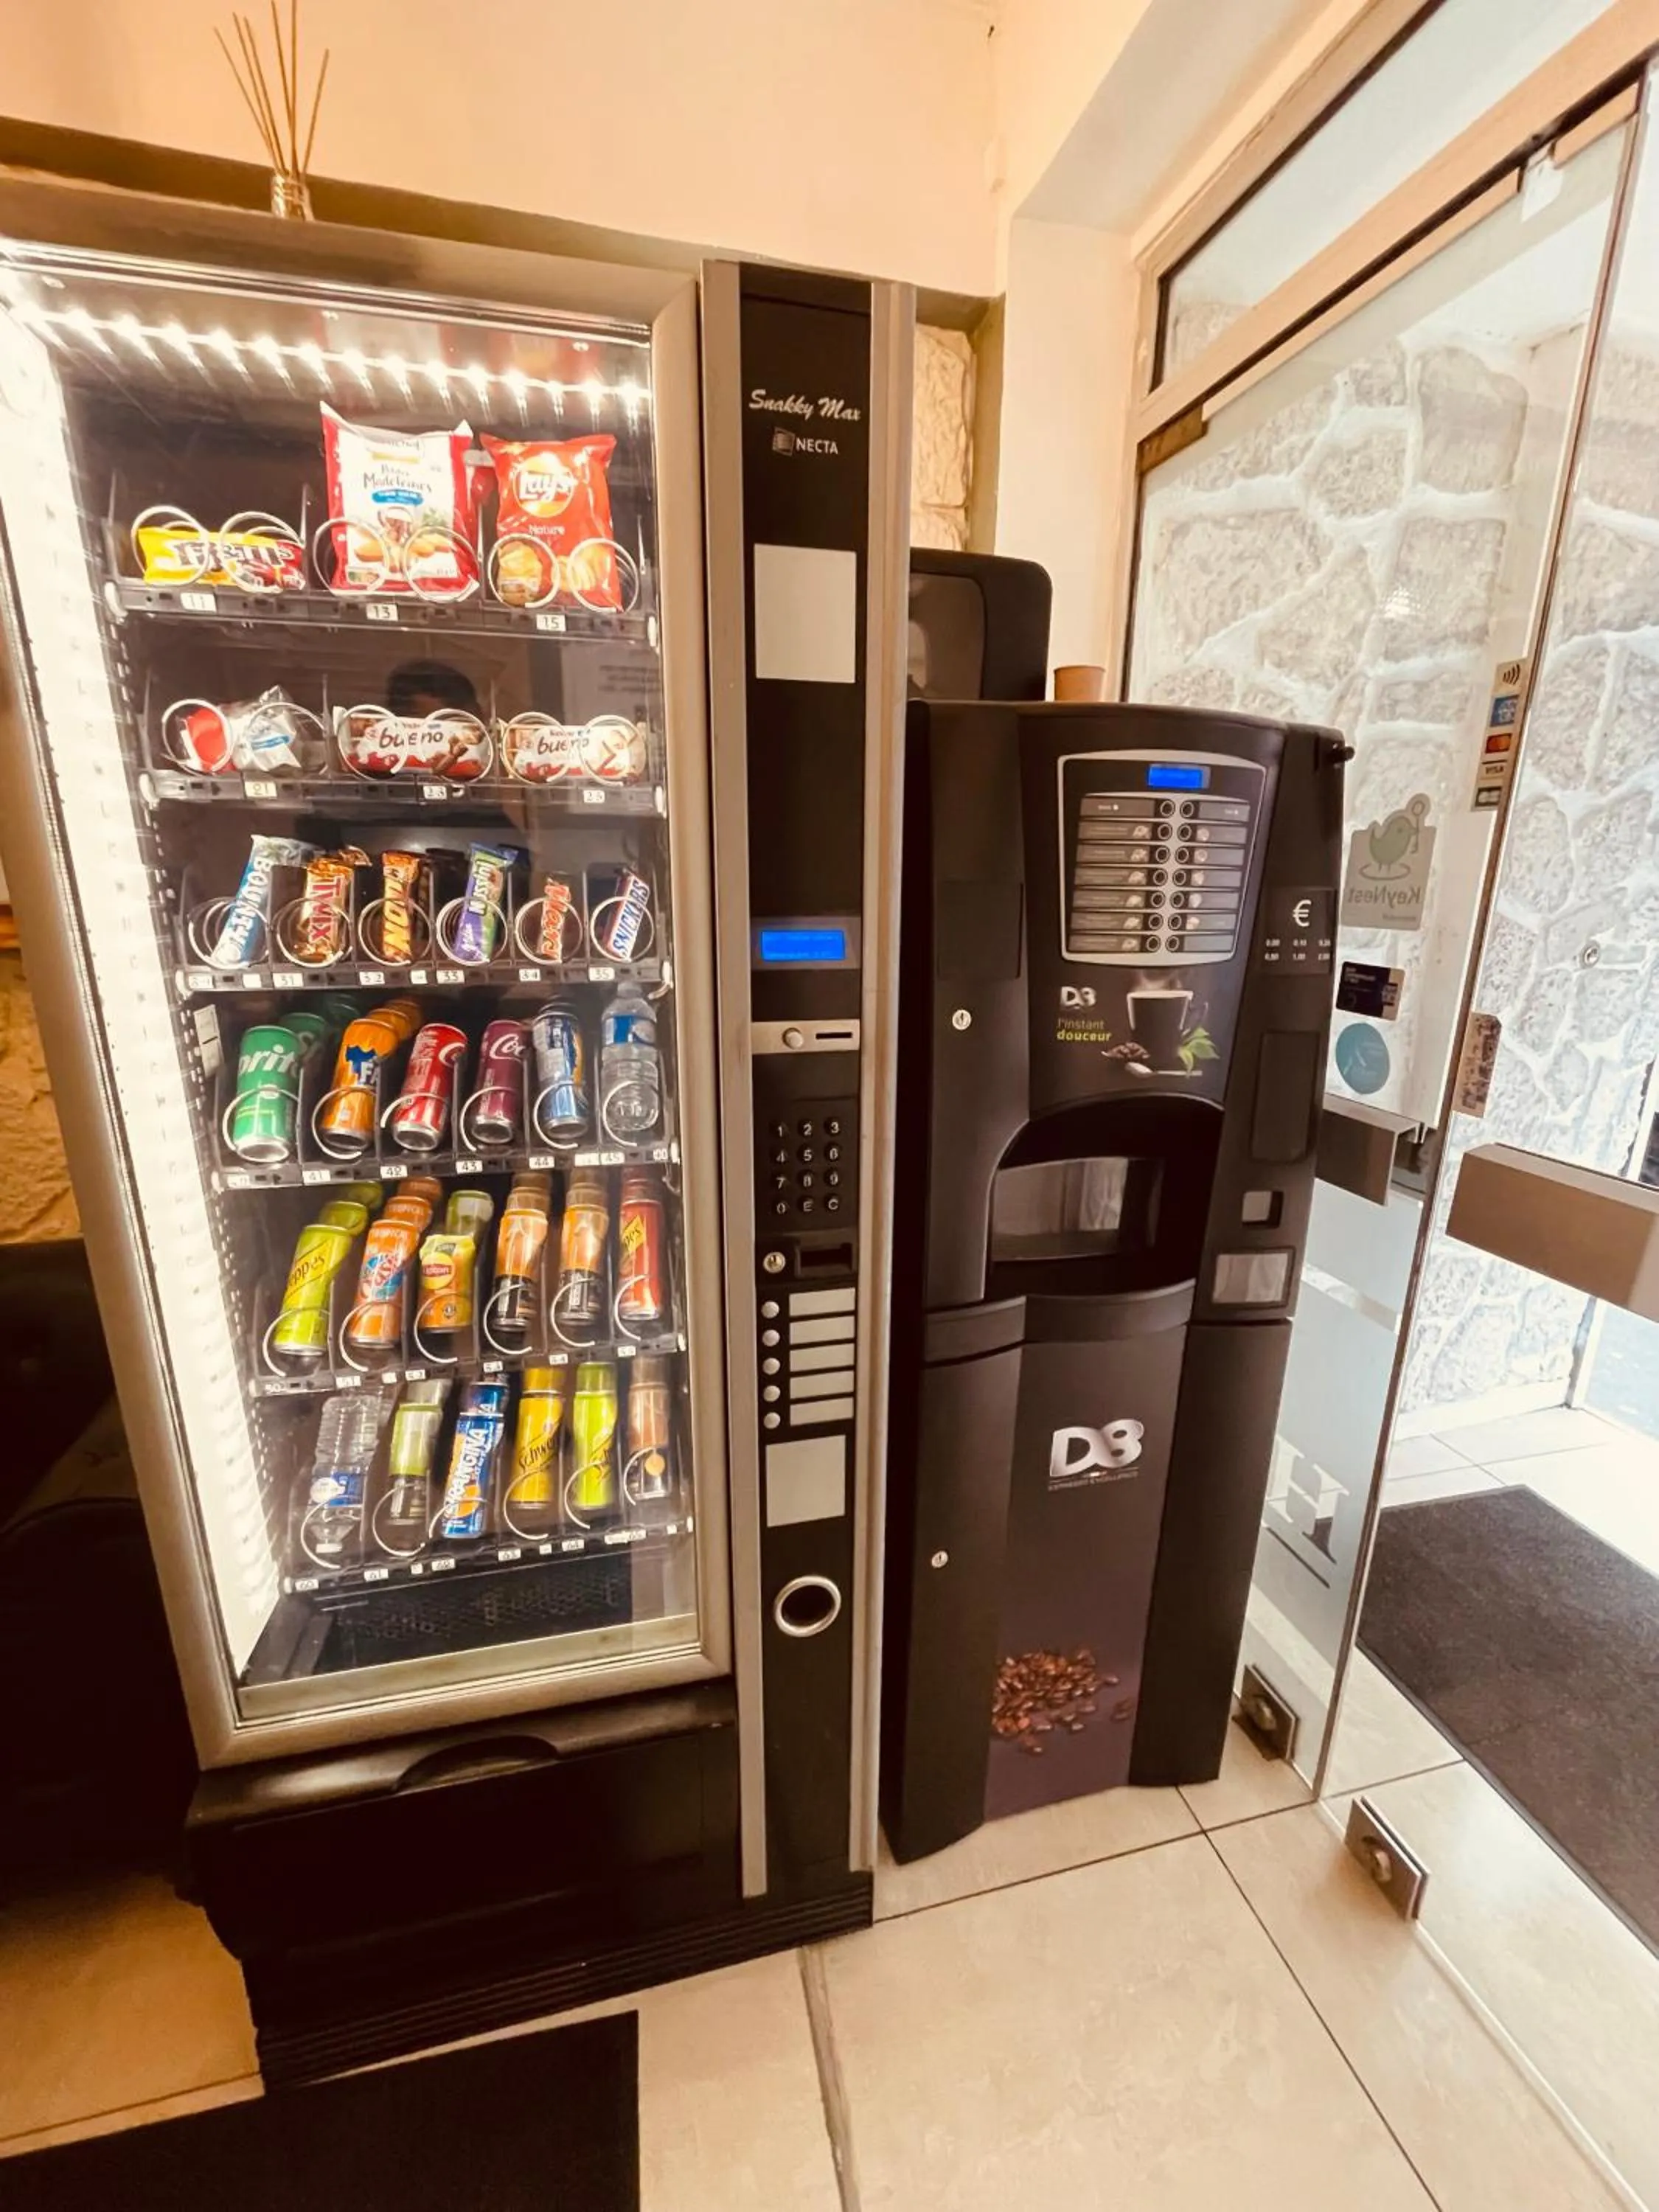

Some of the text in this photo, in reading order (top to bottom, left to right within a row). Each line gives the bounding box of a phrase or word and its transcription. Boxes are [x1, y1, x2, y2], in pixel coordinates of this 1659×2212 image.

[748, 389, 861, 421] Snakky Max
[796, 437, 838, 455] NECTA
[374, 605, 390, 619] 13
[543, 616, 560, 628] 15
[379, 727, 443, 748] bueno
[310, 877, 343, 942] TWIX
[1293, 899, 1312, 927] €
[1057, 1029, 1112, 1042] douceur
[777, 1126, 783, 1137] 1
[803, 1124, 812, 1135] 2
[830, 1121, 839, 1133] 3
[776, 1150, 785, 1163] 4
[803, 1149, 812, 1161] 5
[830, 1147, 838, 1160] 6
[462, 1161, 477, 1172] 43
[776, 1176, 786, 1189] 7
[803, 1175, 811, 1187] 8
[830, 1173, 838, 1186] 9
[776, 1202, 785, 1214] 0
[803, 1200, 812, 1211] E
[828, 1198, 838, 1210] C
